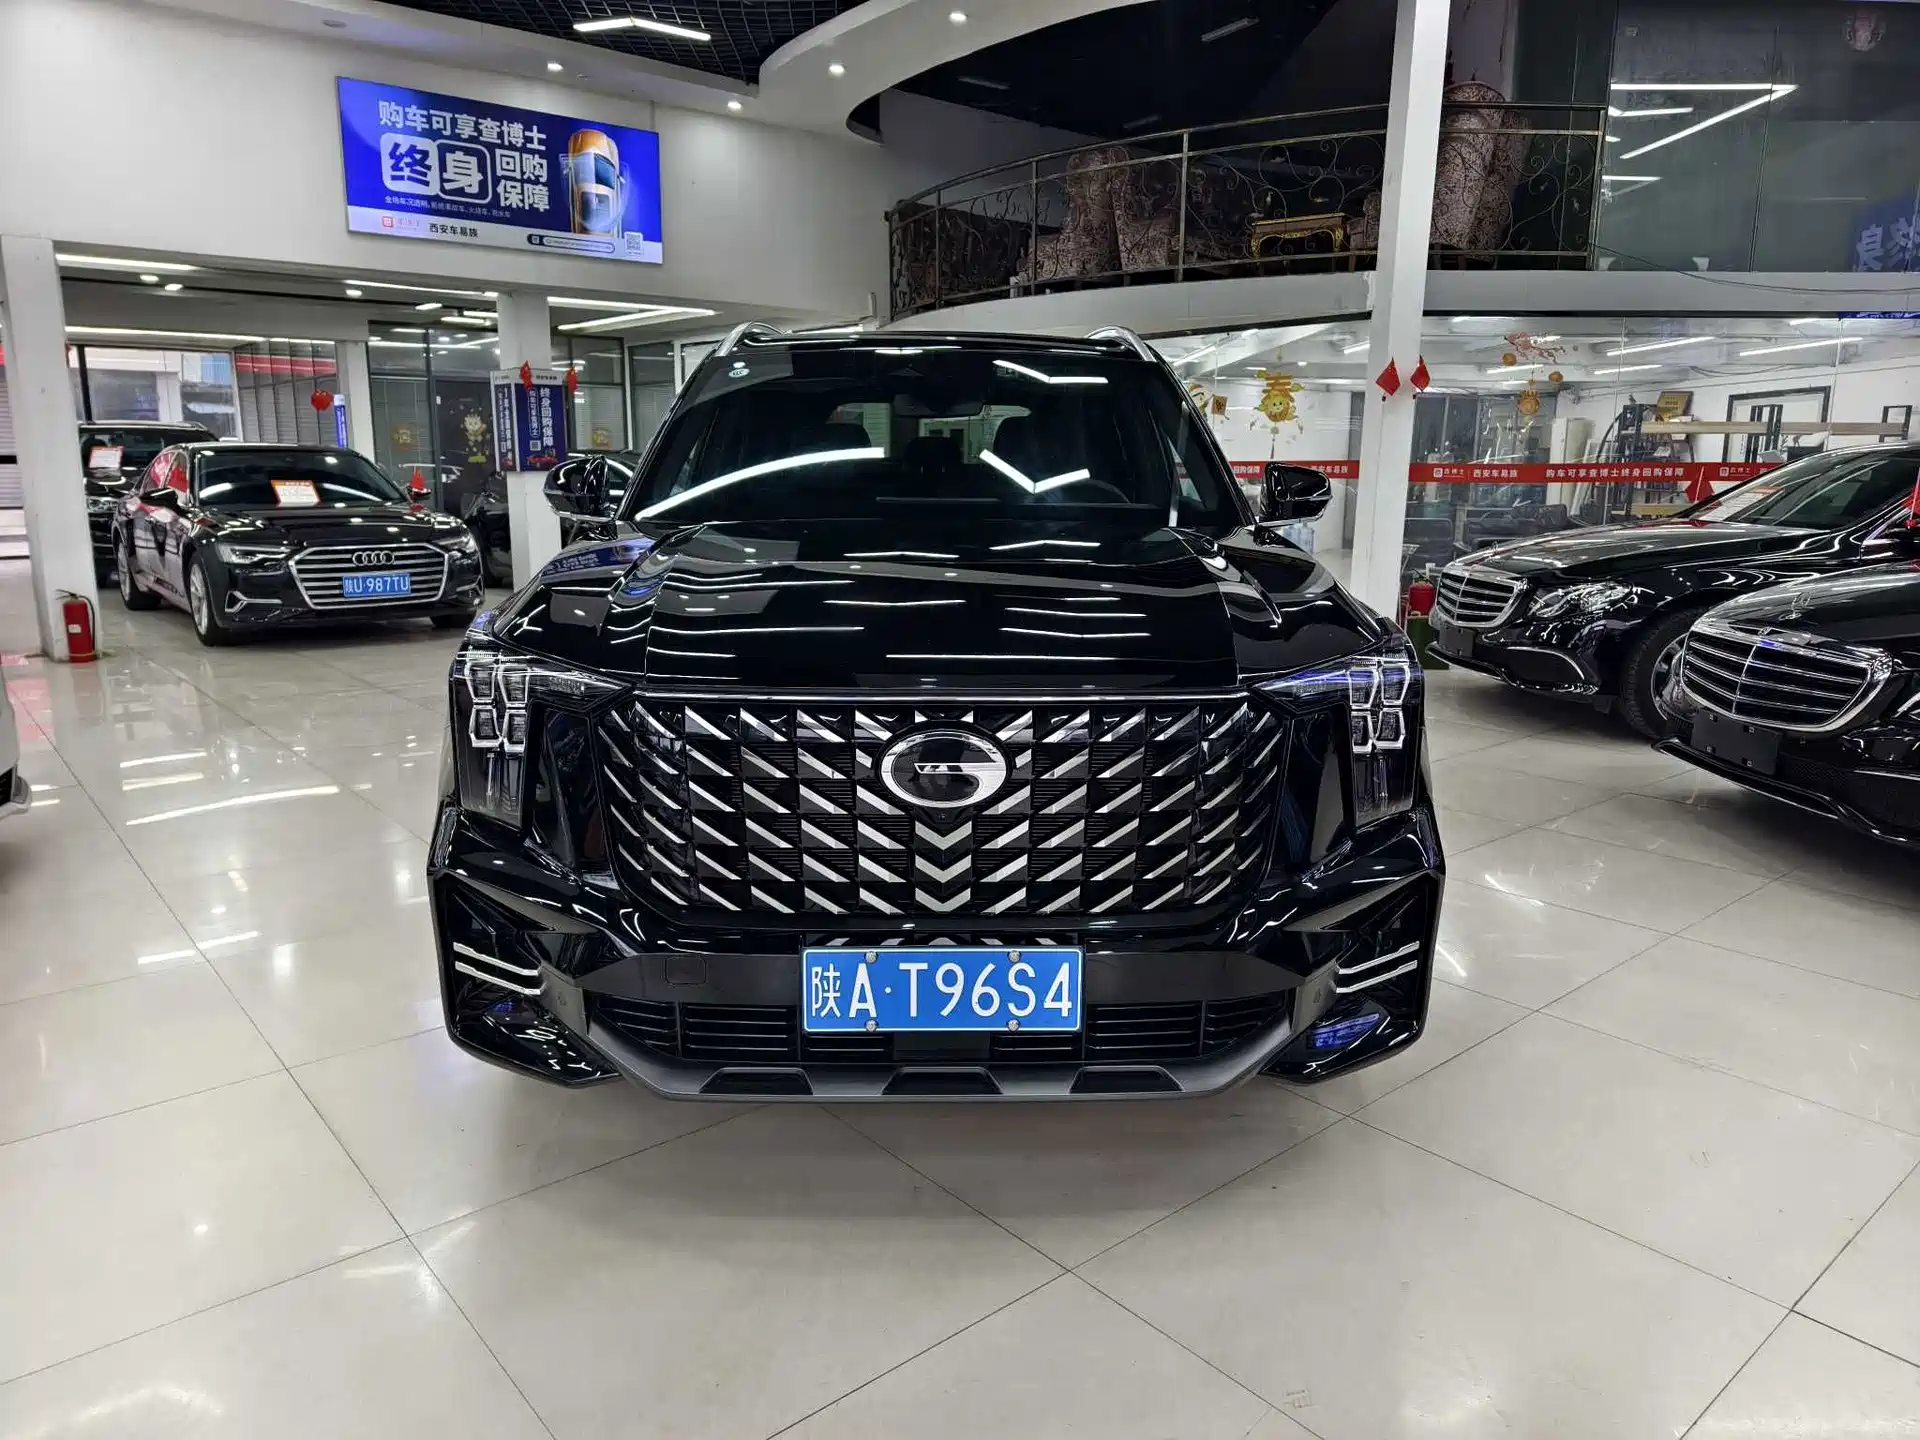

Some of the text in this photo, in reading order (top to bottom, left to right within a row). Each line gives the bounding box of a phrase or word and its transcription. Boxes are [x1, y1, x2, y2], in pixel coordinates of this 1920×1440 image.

[378, 101, 547, 150] 购车可享查博士
[387, 143, 483, 194] 终身
[495, 148, 547, 183] 回购
[496, 180, 550, 213] 保障
[540, 387, 554, 447] 终身回购保障
[1546, 467, 1684, 478] 购车可享查博士终身回购保障
[811, 962, 1072, 1018] 陕A·T96S4
